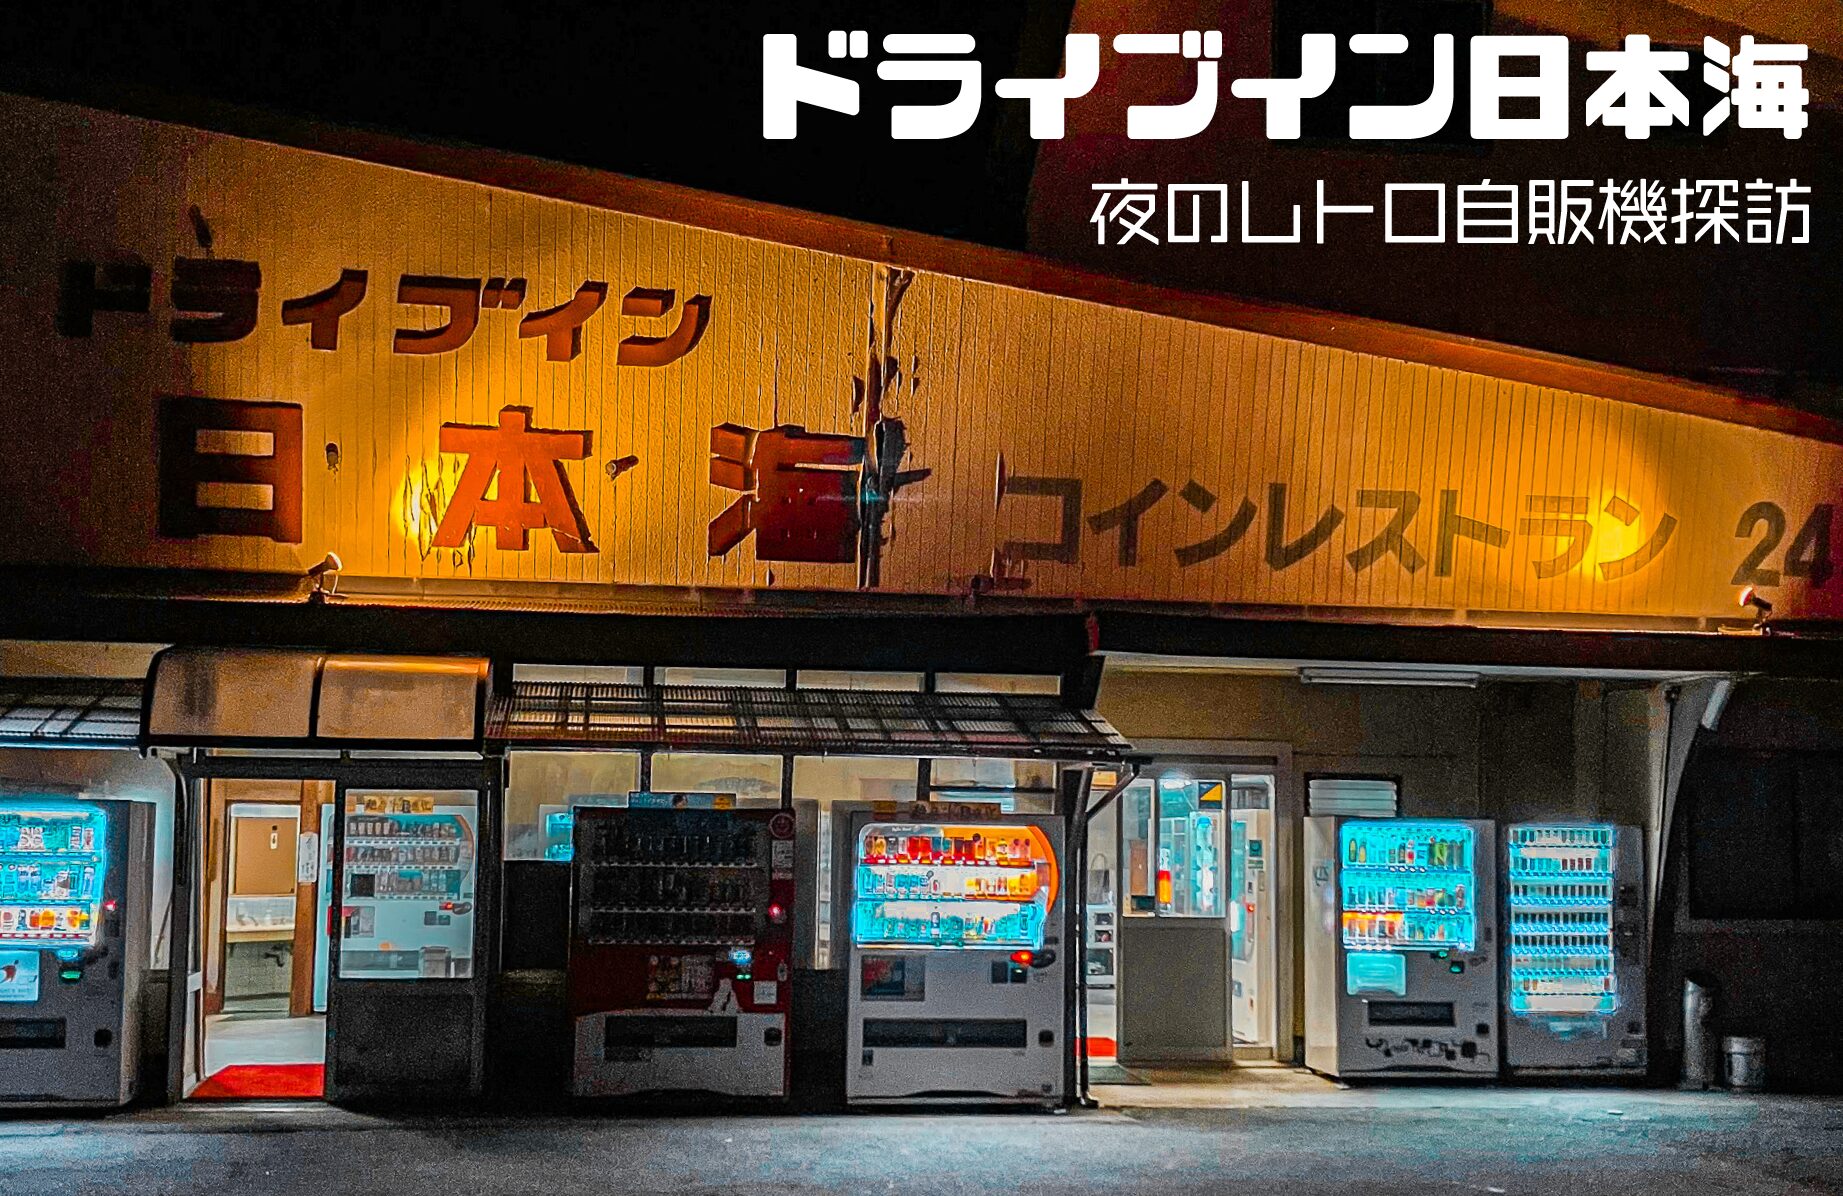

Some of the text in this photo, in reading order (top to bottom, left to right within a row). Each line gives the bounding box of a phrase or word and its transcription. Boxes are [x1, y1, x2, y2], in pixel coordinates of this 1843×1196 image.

[56, 257, 711, 366] ドライブイン
[158, 397, 868, 564] 日本海
[1005, 475, 1834, 588] コインレストラン 24
